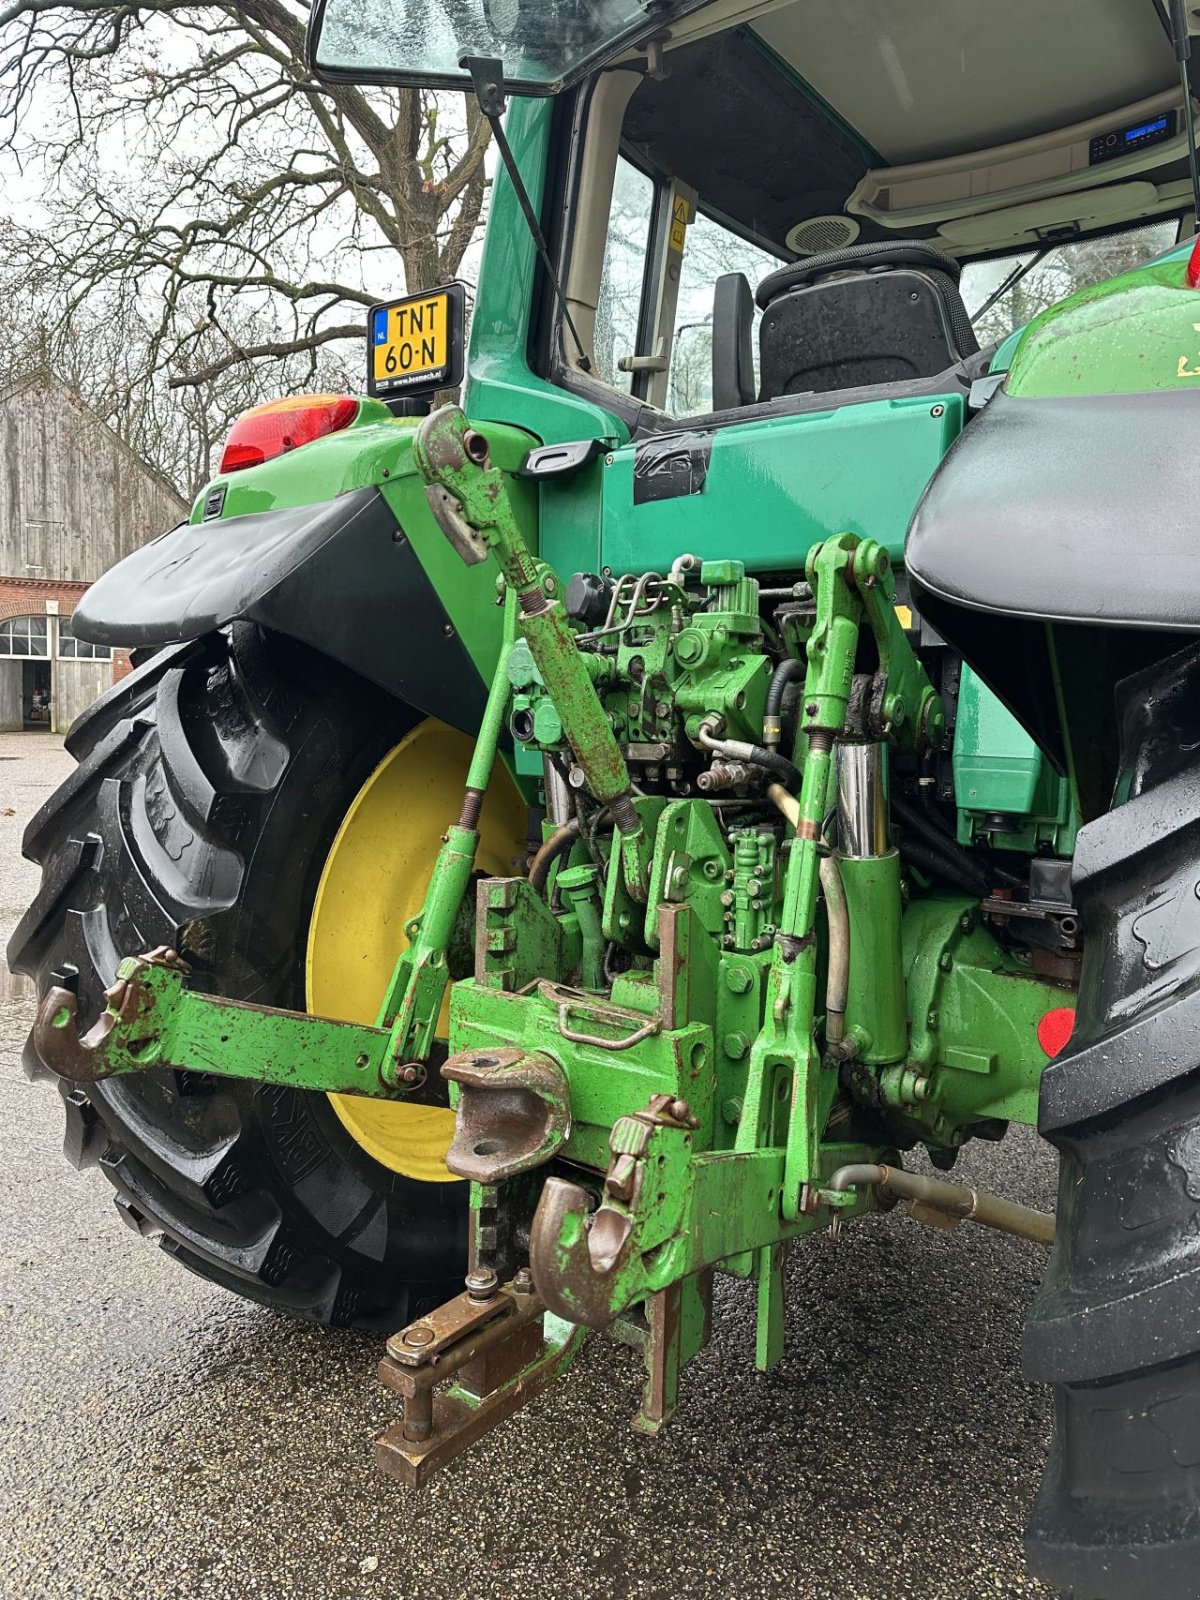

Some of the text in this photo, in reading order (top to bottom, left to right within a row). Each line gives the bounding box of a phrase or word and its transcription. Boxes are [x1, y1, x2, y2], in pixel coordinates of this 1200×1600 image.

[377, 331, 386, 341] NL
[396, 301, 439, 338] TNT
[385, 336, 435, 373] 60-N
